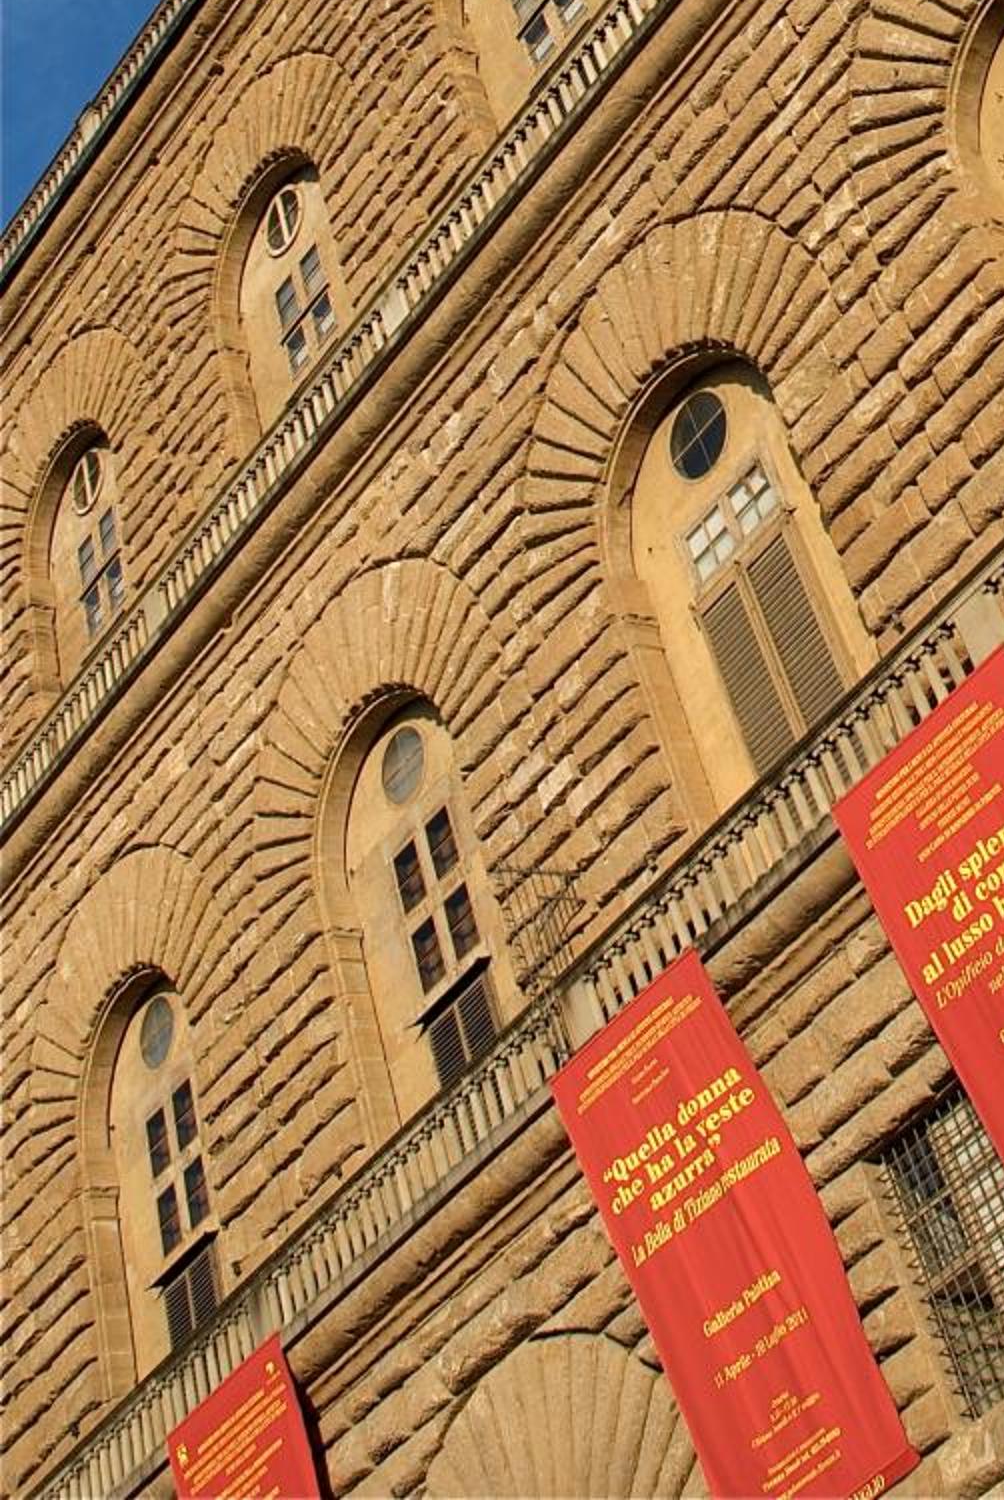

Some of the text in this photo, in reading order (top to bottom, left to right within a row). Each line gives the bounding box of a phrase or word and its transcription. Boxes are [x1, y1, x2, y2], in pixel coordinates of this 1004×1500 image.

[904, 870, 963, 927] Dagli
[952, 891, 973, 921] di
[923, 952, 945, 984] al
[942, 913, 993, 964] lusso
[603, 1123, 677, 1182] “Quella
[678, 1068, 741, 1126] donna
[612, 1088, 755, 1214] che ha la veste
[650, 1133, 721, 1211] azurra”
[673, 1208, 686, 1233] di
